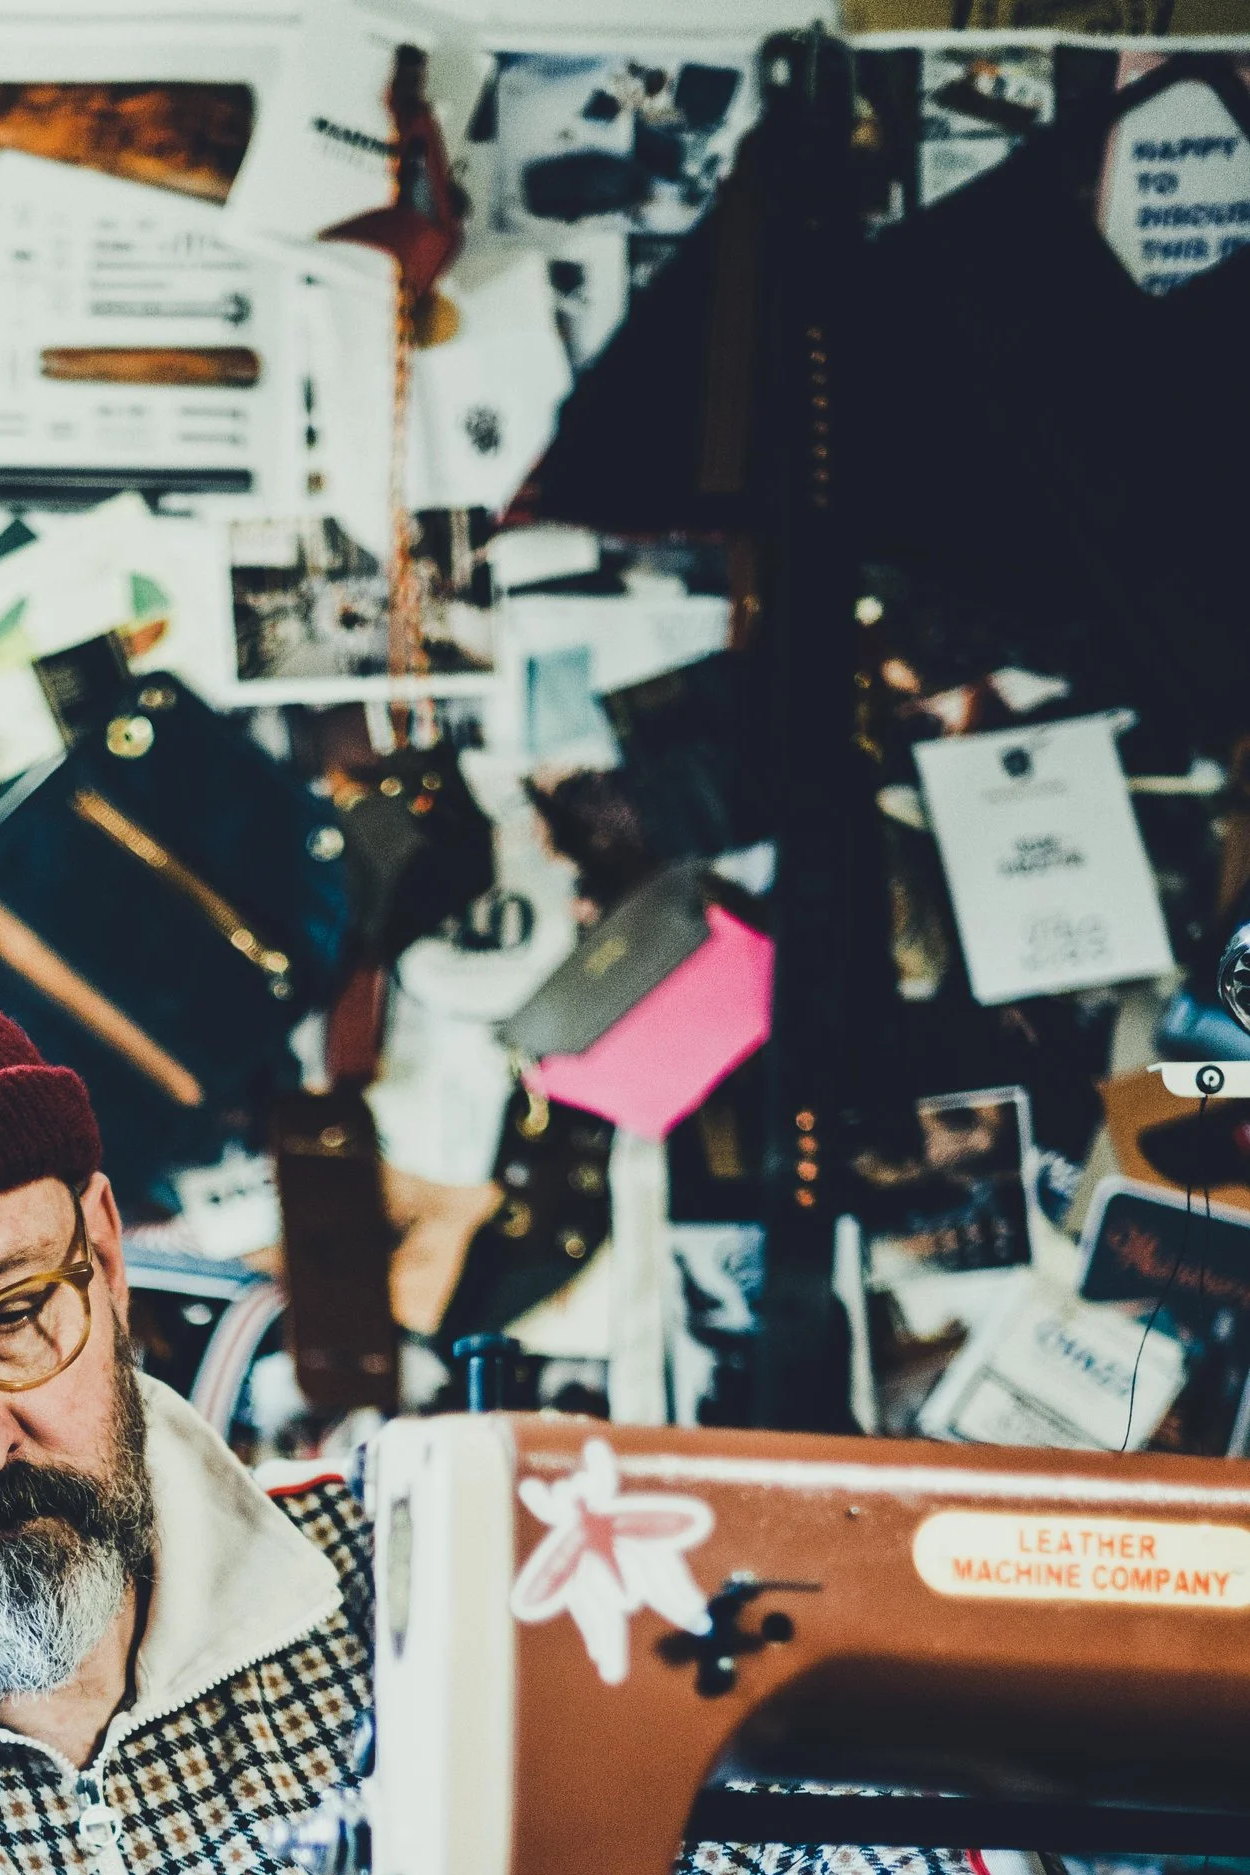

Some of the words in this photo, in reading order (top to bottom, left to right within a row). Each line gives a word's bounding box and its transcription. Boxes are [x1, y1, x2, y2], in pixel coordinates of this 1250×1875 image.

[1132, 135, 1238, 162] HAPPY
[1135, 171, 1179, 196] TO
[1017, 1528, 1156, 1561] LEATHER
[952, 1557, 1082, 1590] MACHINE
[1092, 1565, 1231, 1598] COMPANY
